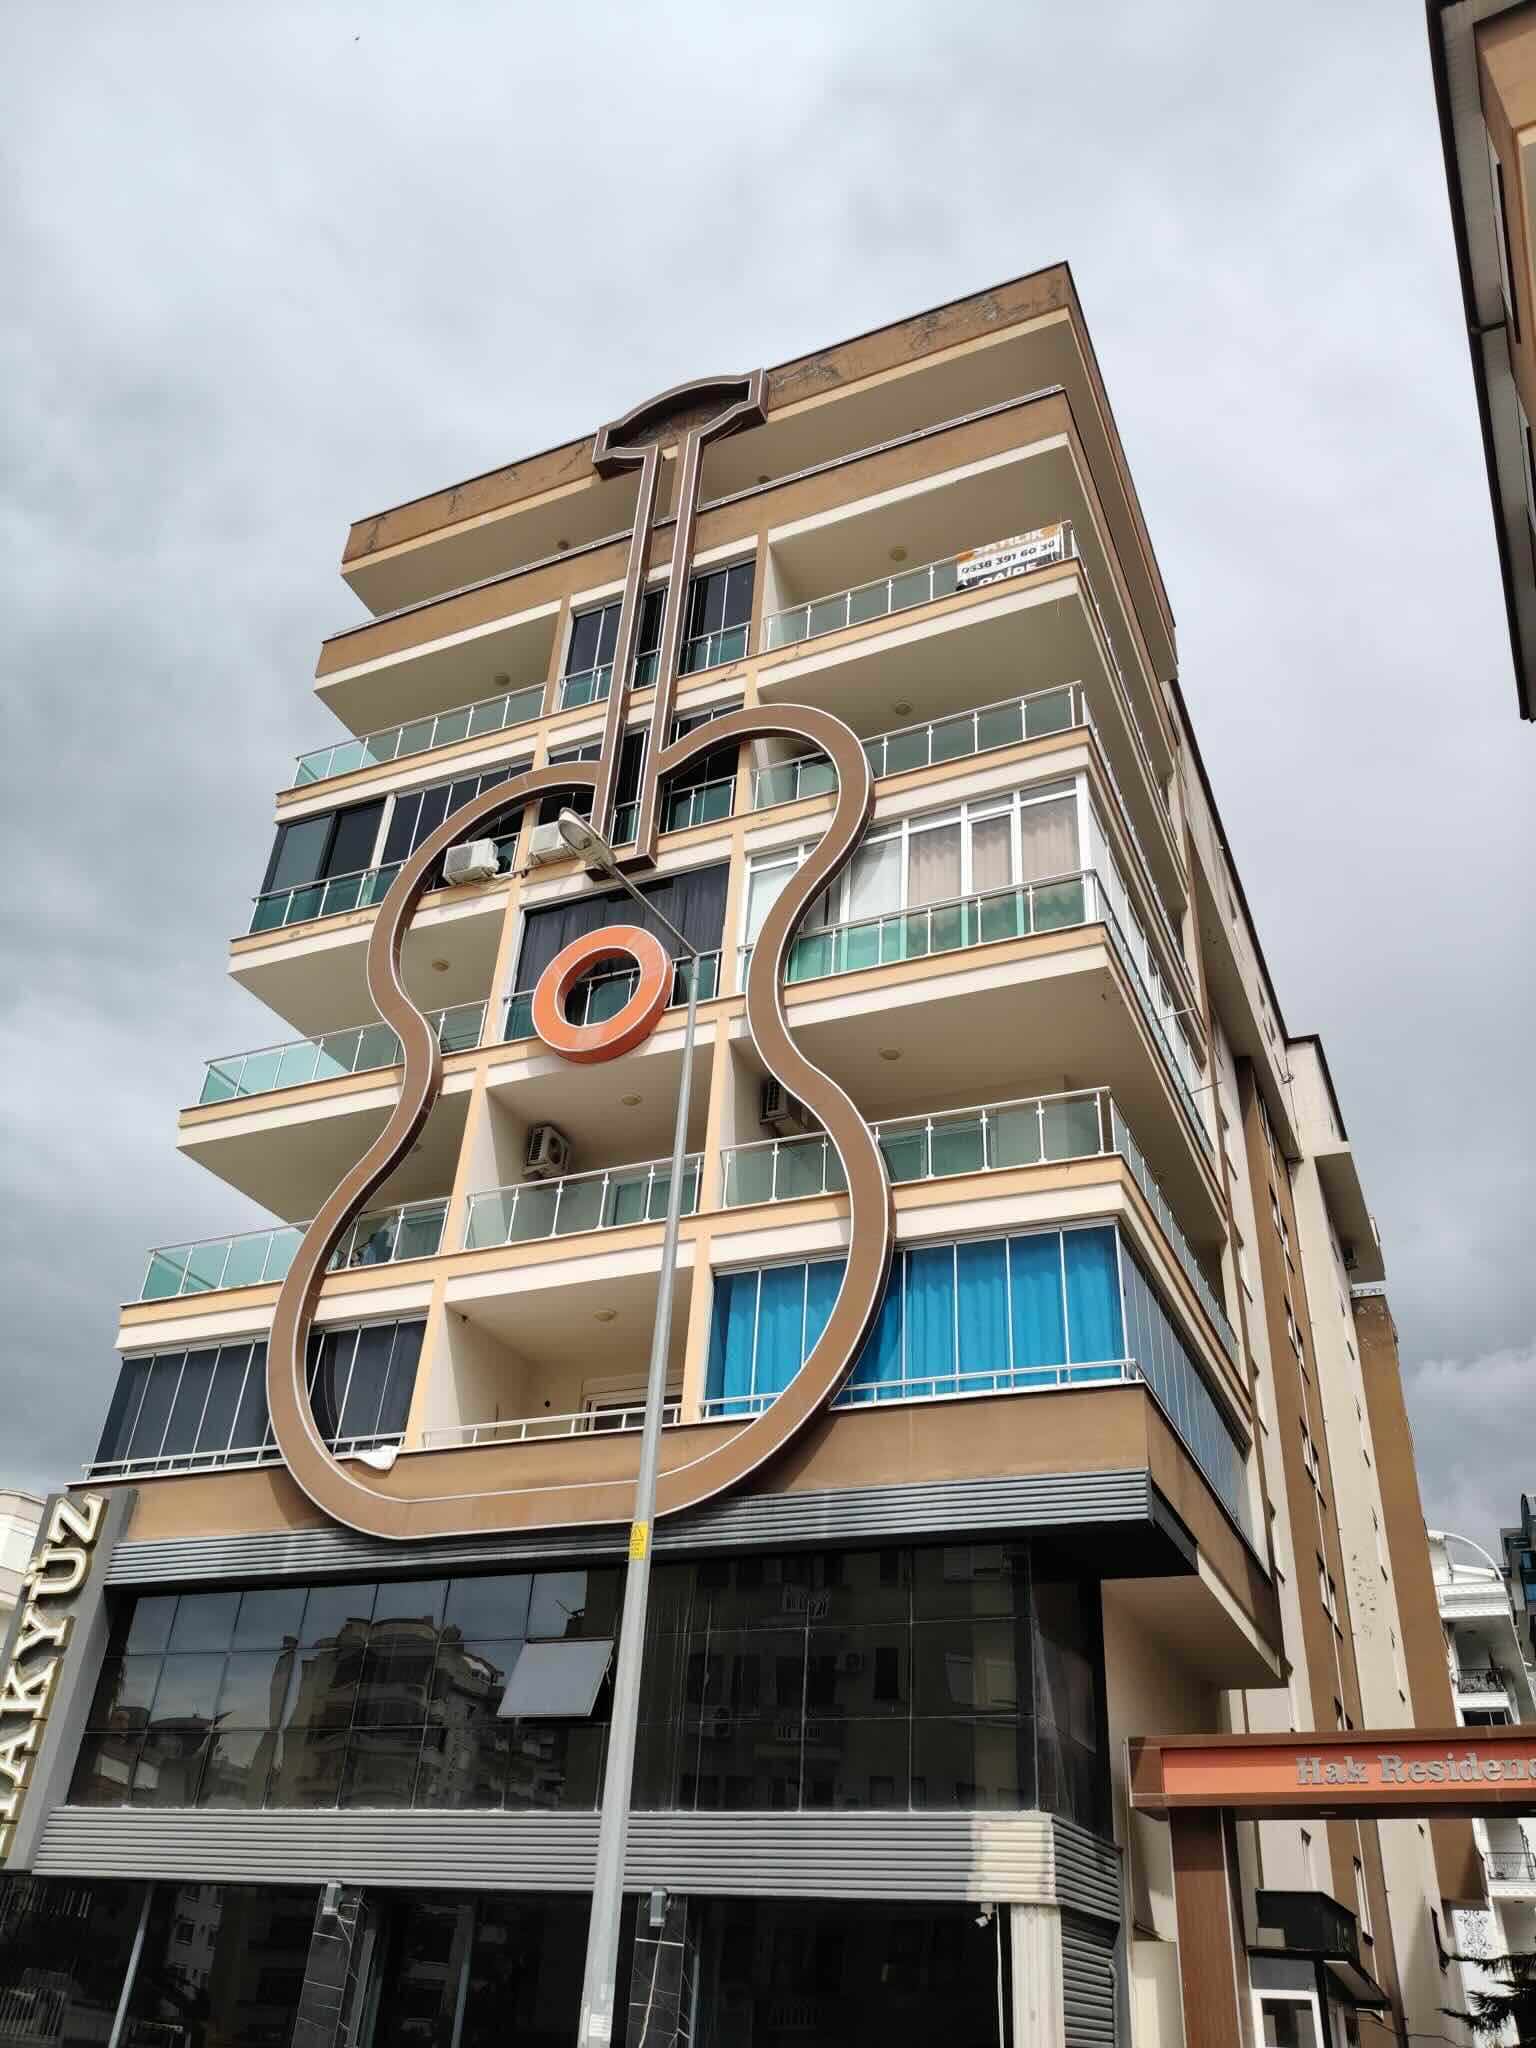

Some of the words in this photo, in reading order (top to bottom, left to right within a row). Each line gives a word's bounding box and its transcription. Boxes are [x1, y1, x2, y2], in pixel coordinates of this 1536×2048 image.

[996, 553, 1017, 566] 391
[1020, 546, 1037, 558] 60
[0, 1493, 106, 1858] AKYÜZ
[1296, 1755, 1369, 1786] Hak
